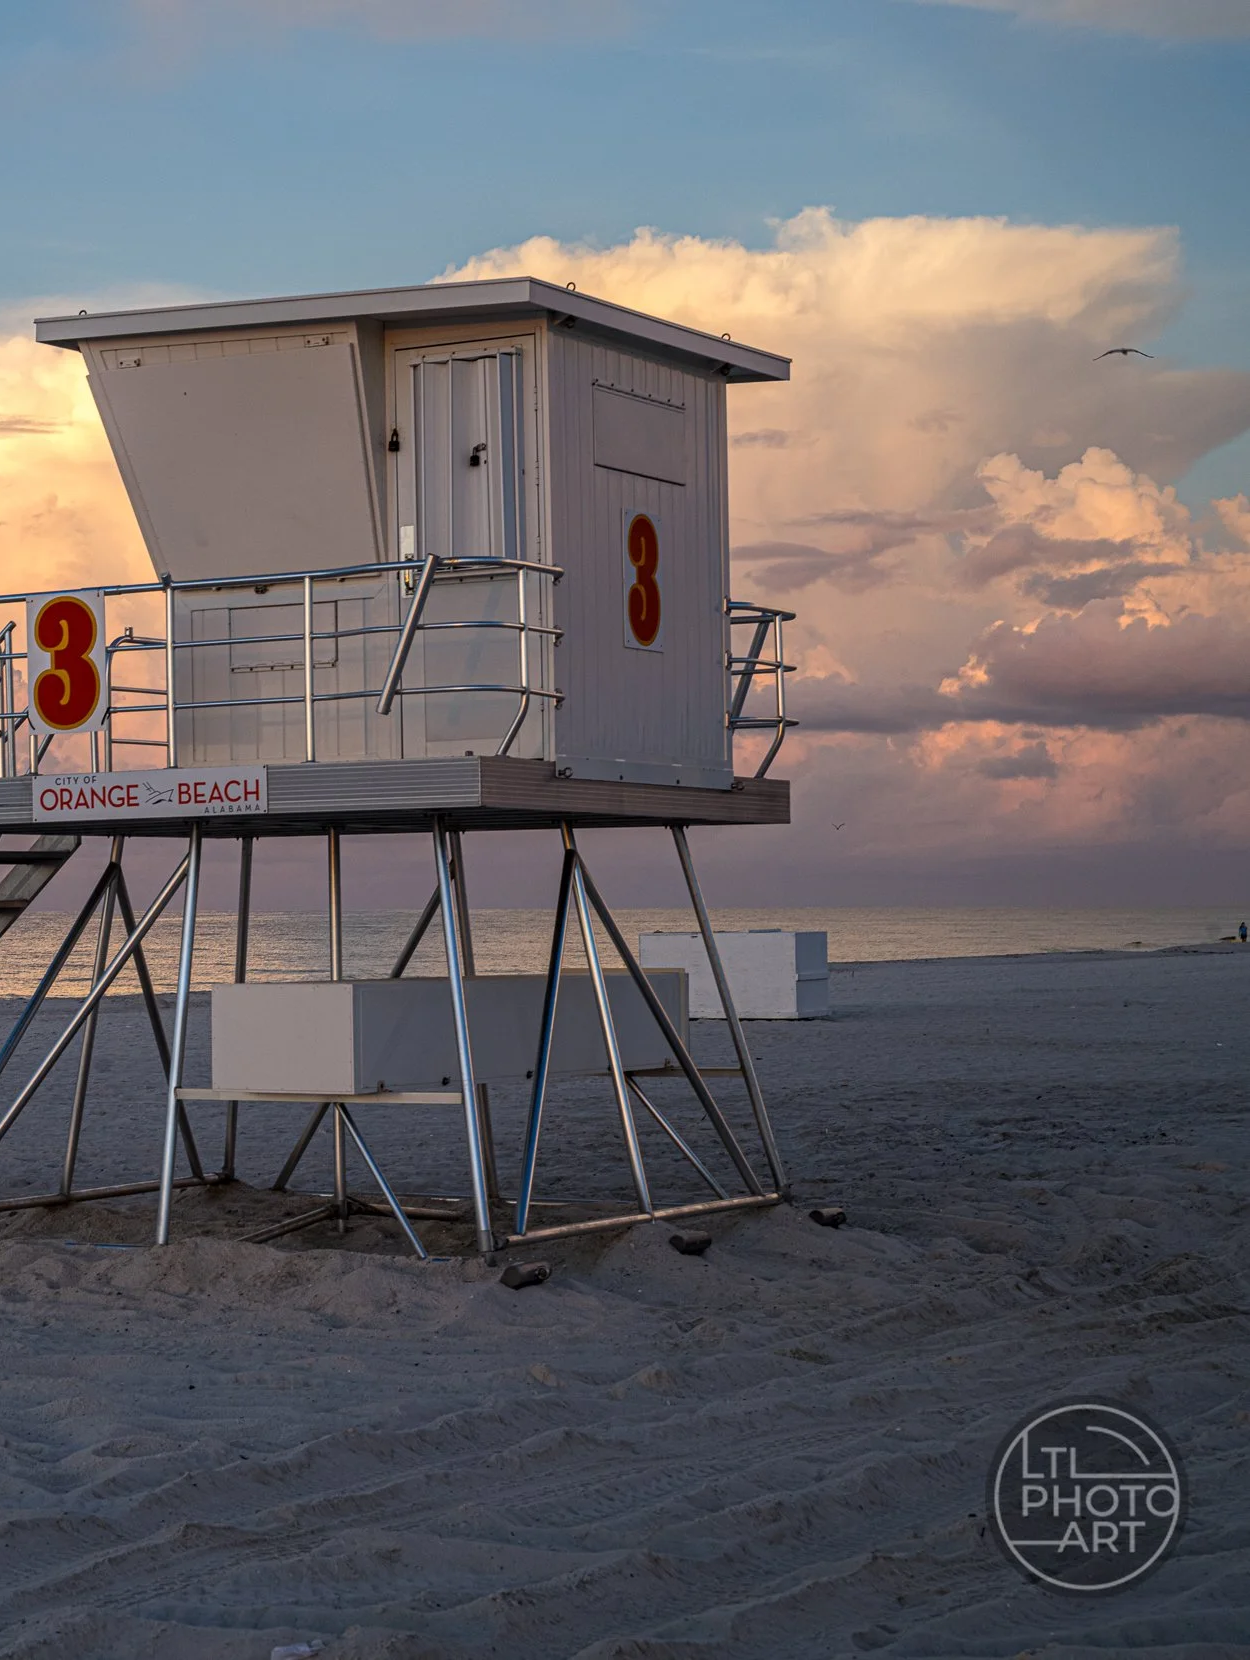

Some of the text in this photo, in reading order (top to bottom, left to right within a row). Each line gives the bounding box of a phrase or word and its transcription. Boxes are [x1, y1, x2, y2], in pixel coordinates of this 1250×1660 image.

[627, 513, 661, 647] 3
[33, 595, 101, 731] 3
[39, 779, 260, 811] ORANGE BEACH
[55, 775, 97, 786] CITY OF
[204, 803, 261, 814] ALABAMA
